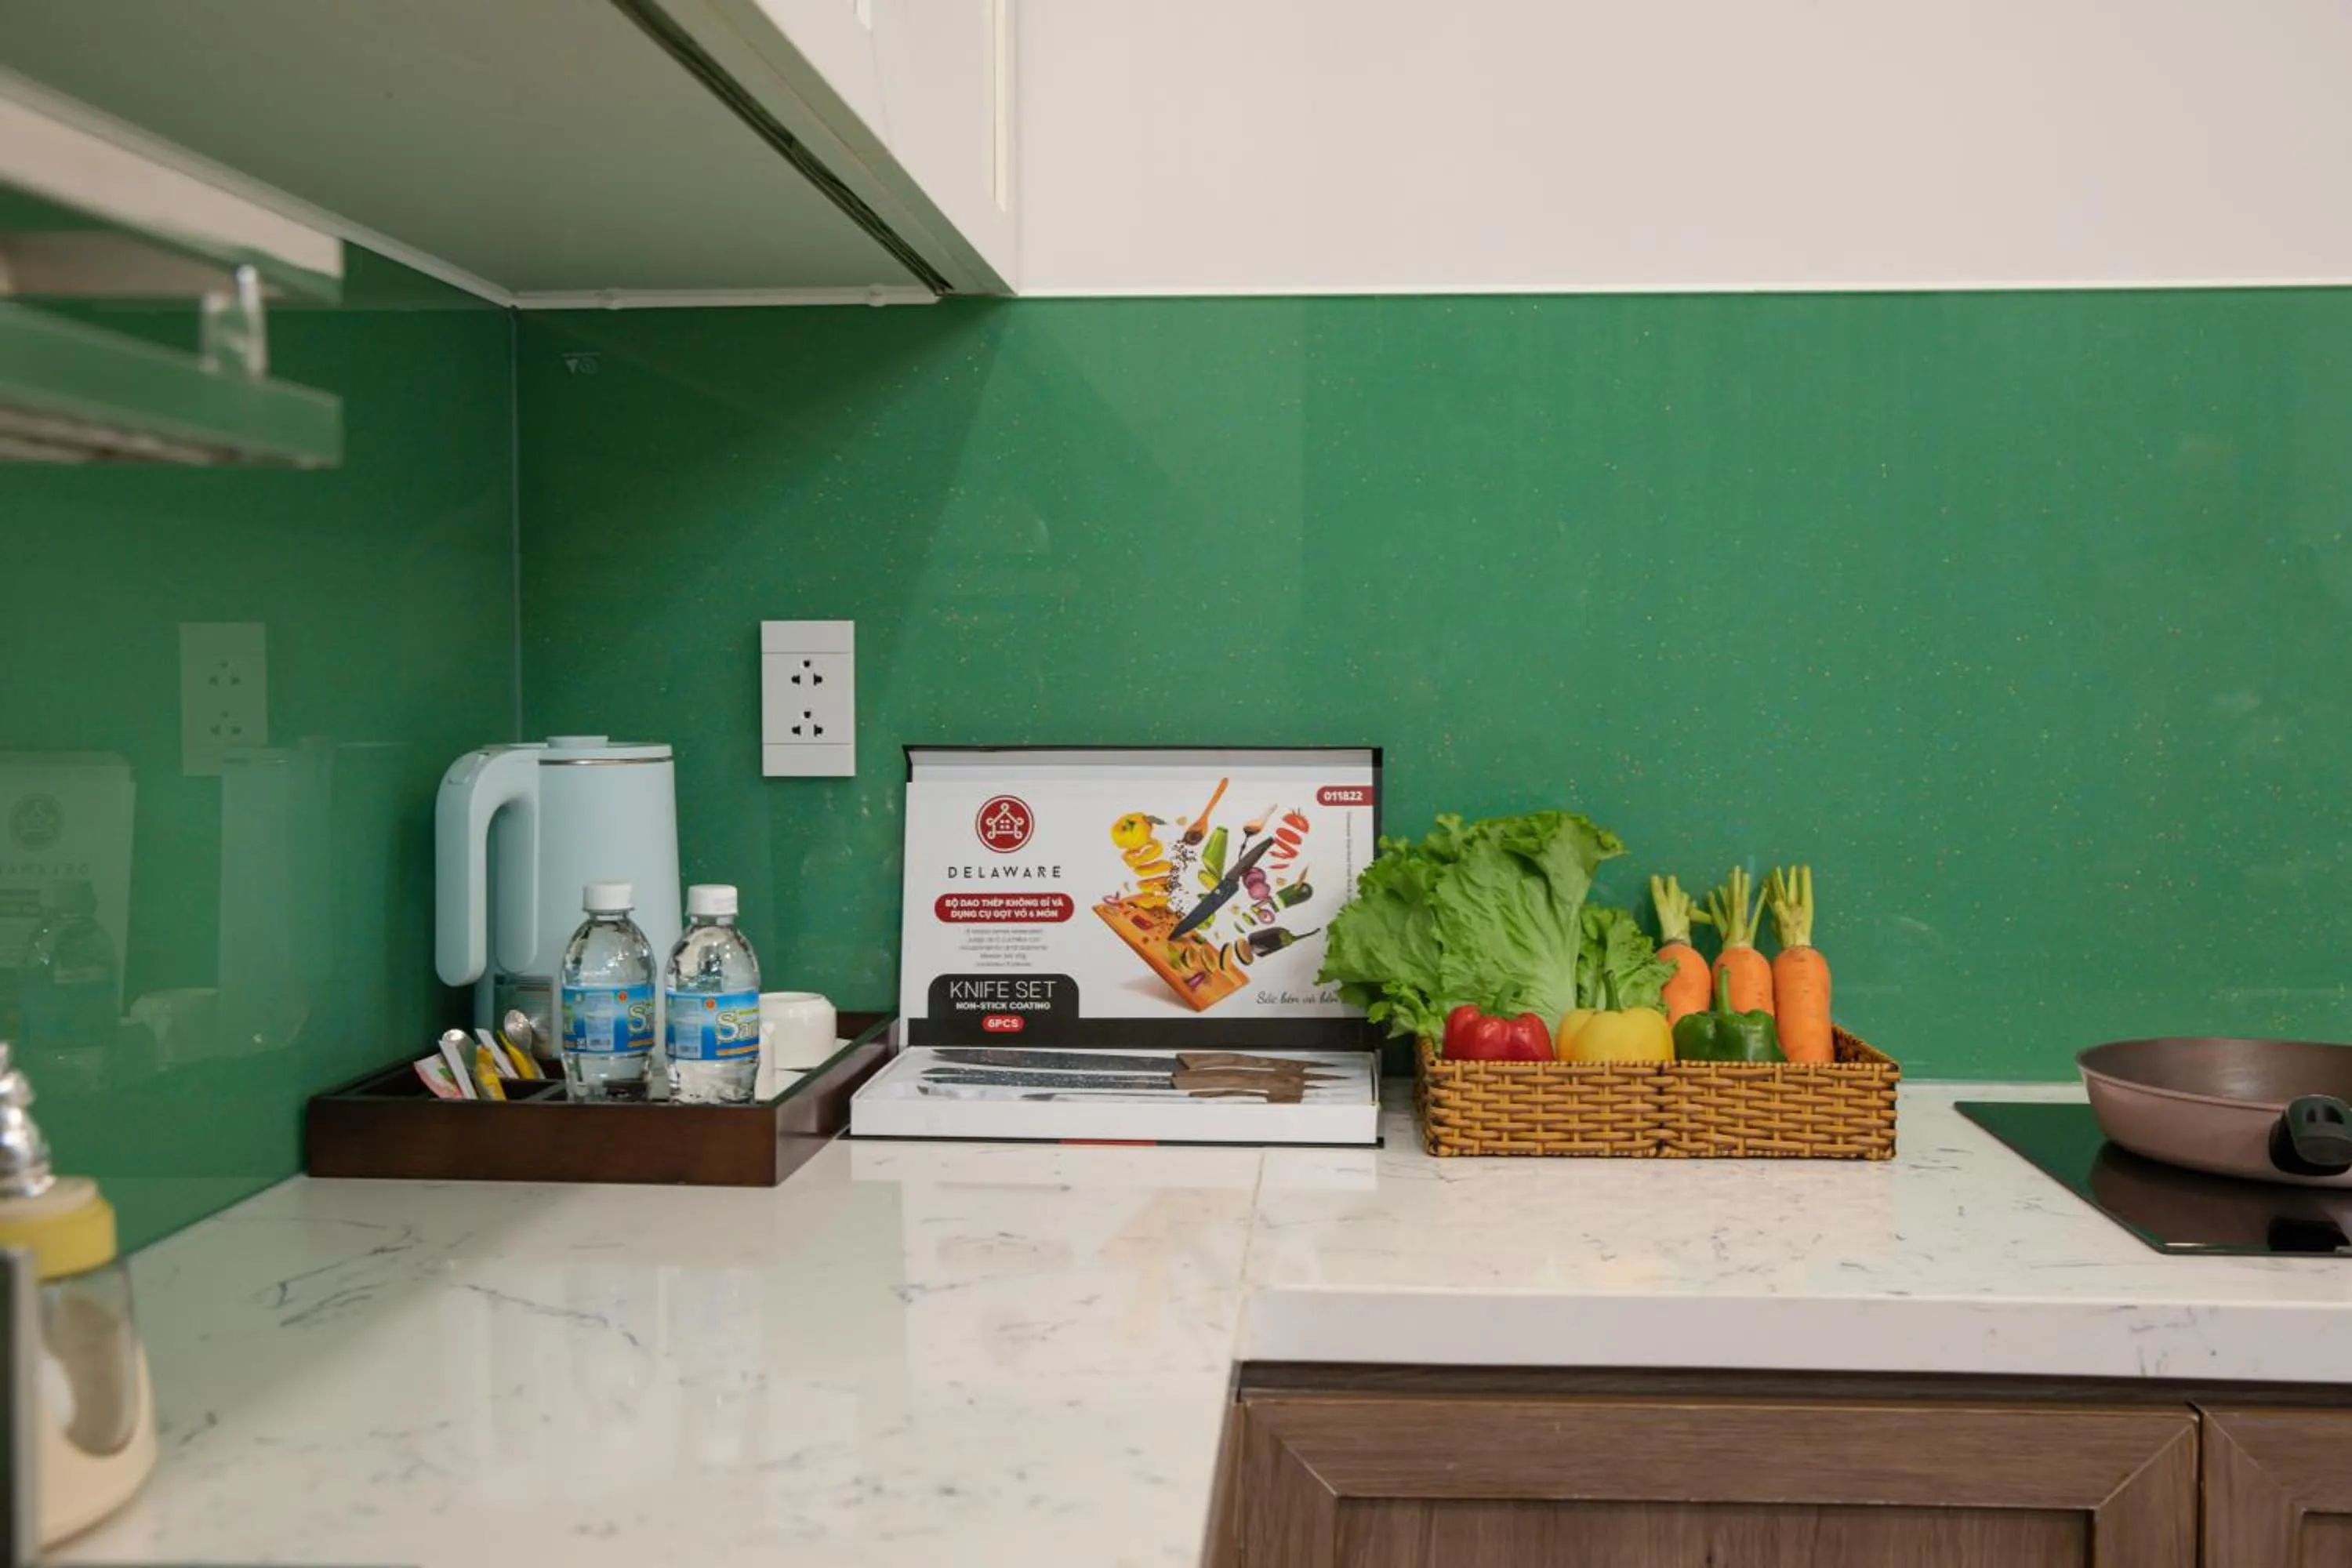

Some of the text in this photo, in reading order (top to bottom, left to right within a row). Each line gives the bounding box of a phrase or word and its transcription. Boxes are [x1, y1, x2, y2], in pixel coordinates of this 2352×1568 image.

[1323, 791, 1363, 801] 011822
[948, 866, 1062, 879] DELAWARE
[1006, 898, 1039, 907] KHÔNG
[951, 909, 977, 919] DỤNG
[978, 909, 992, 919] CỤ
[949, 980, 1058, 999] KNIFE SET
[956, 1001, 1051, 1011] NON-STICK COATING
[987, 1018, 1019, 1029] 6PCS
